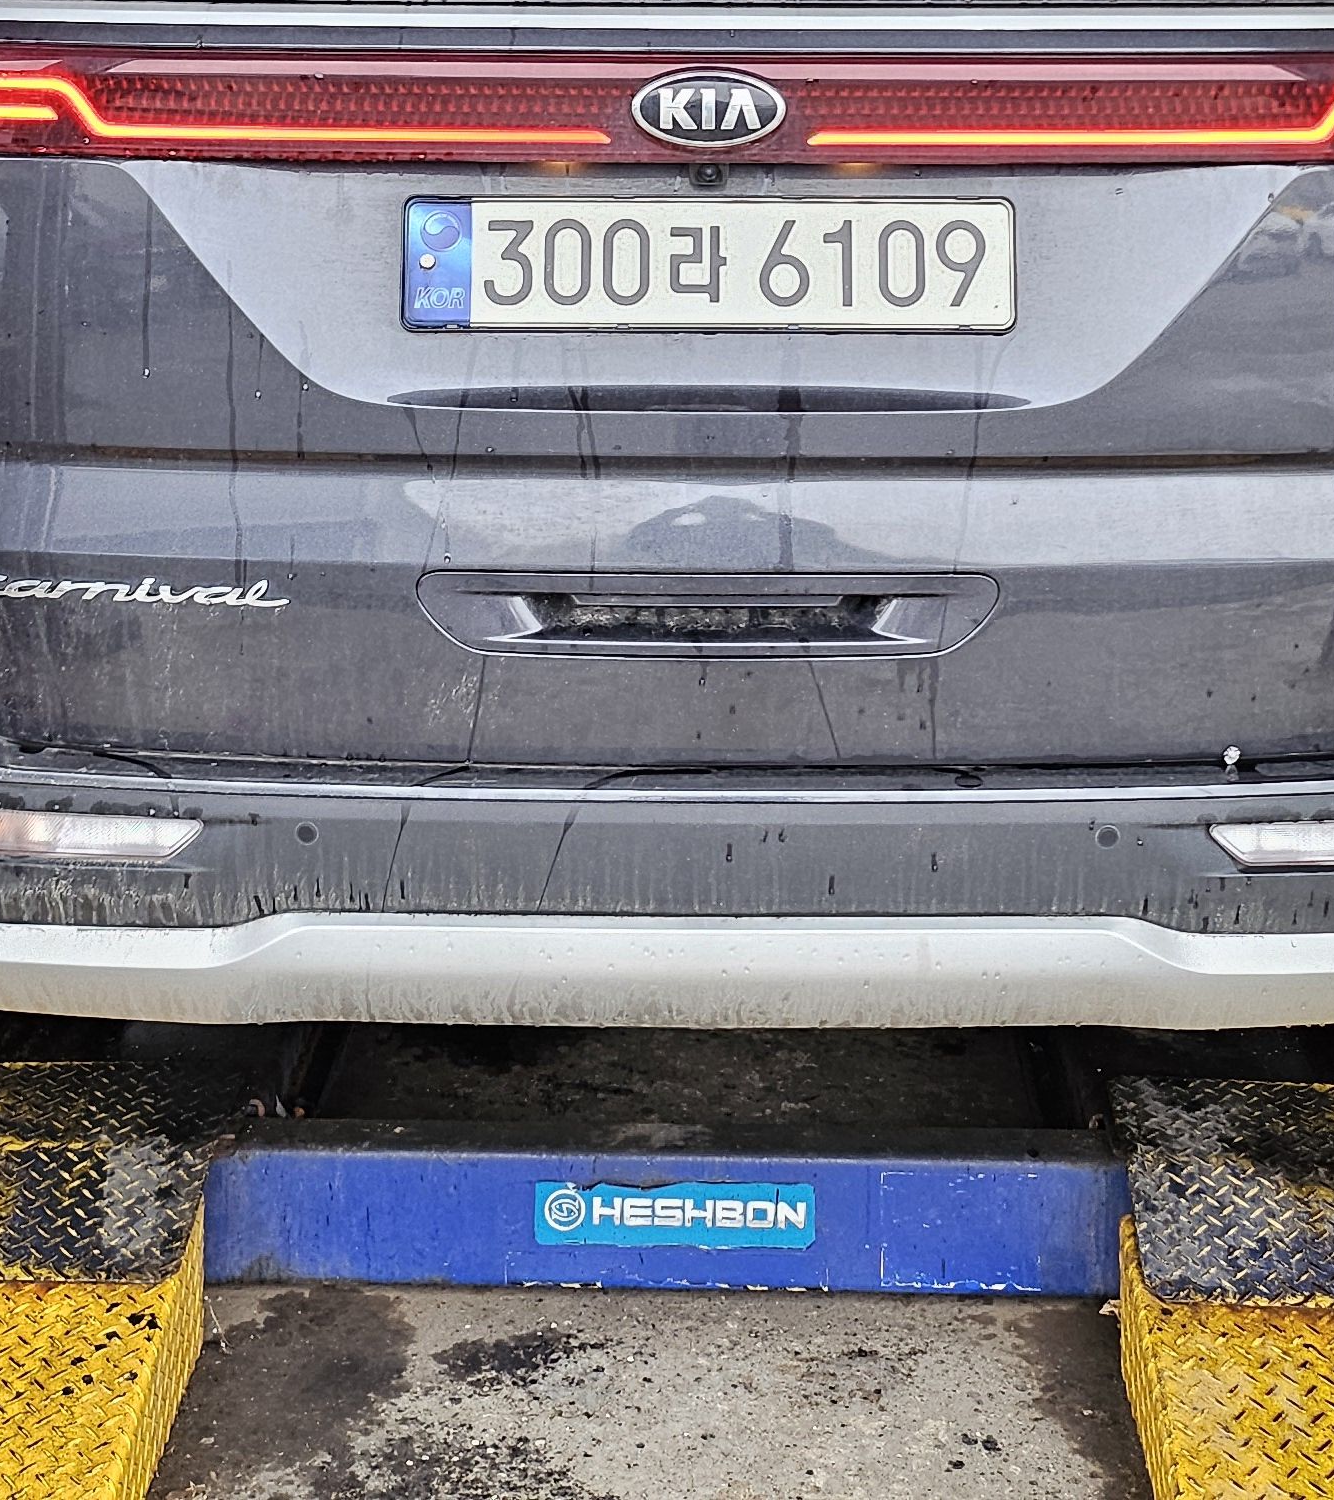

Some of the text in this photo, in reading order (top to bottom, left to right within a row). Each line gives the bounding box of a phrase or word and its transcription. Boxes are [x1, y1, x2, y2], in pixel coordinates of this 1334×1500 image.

[658, 87, 763, 131] KIA
[483, 217, 987, 308] 300라 6109
[413, 286, 466, 309] KOR
[591, 1196, 808, 1231] HESHBON
